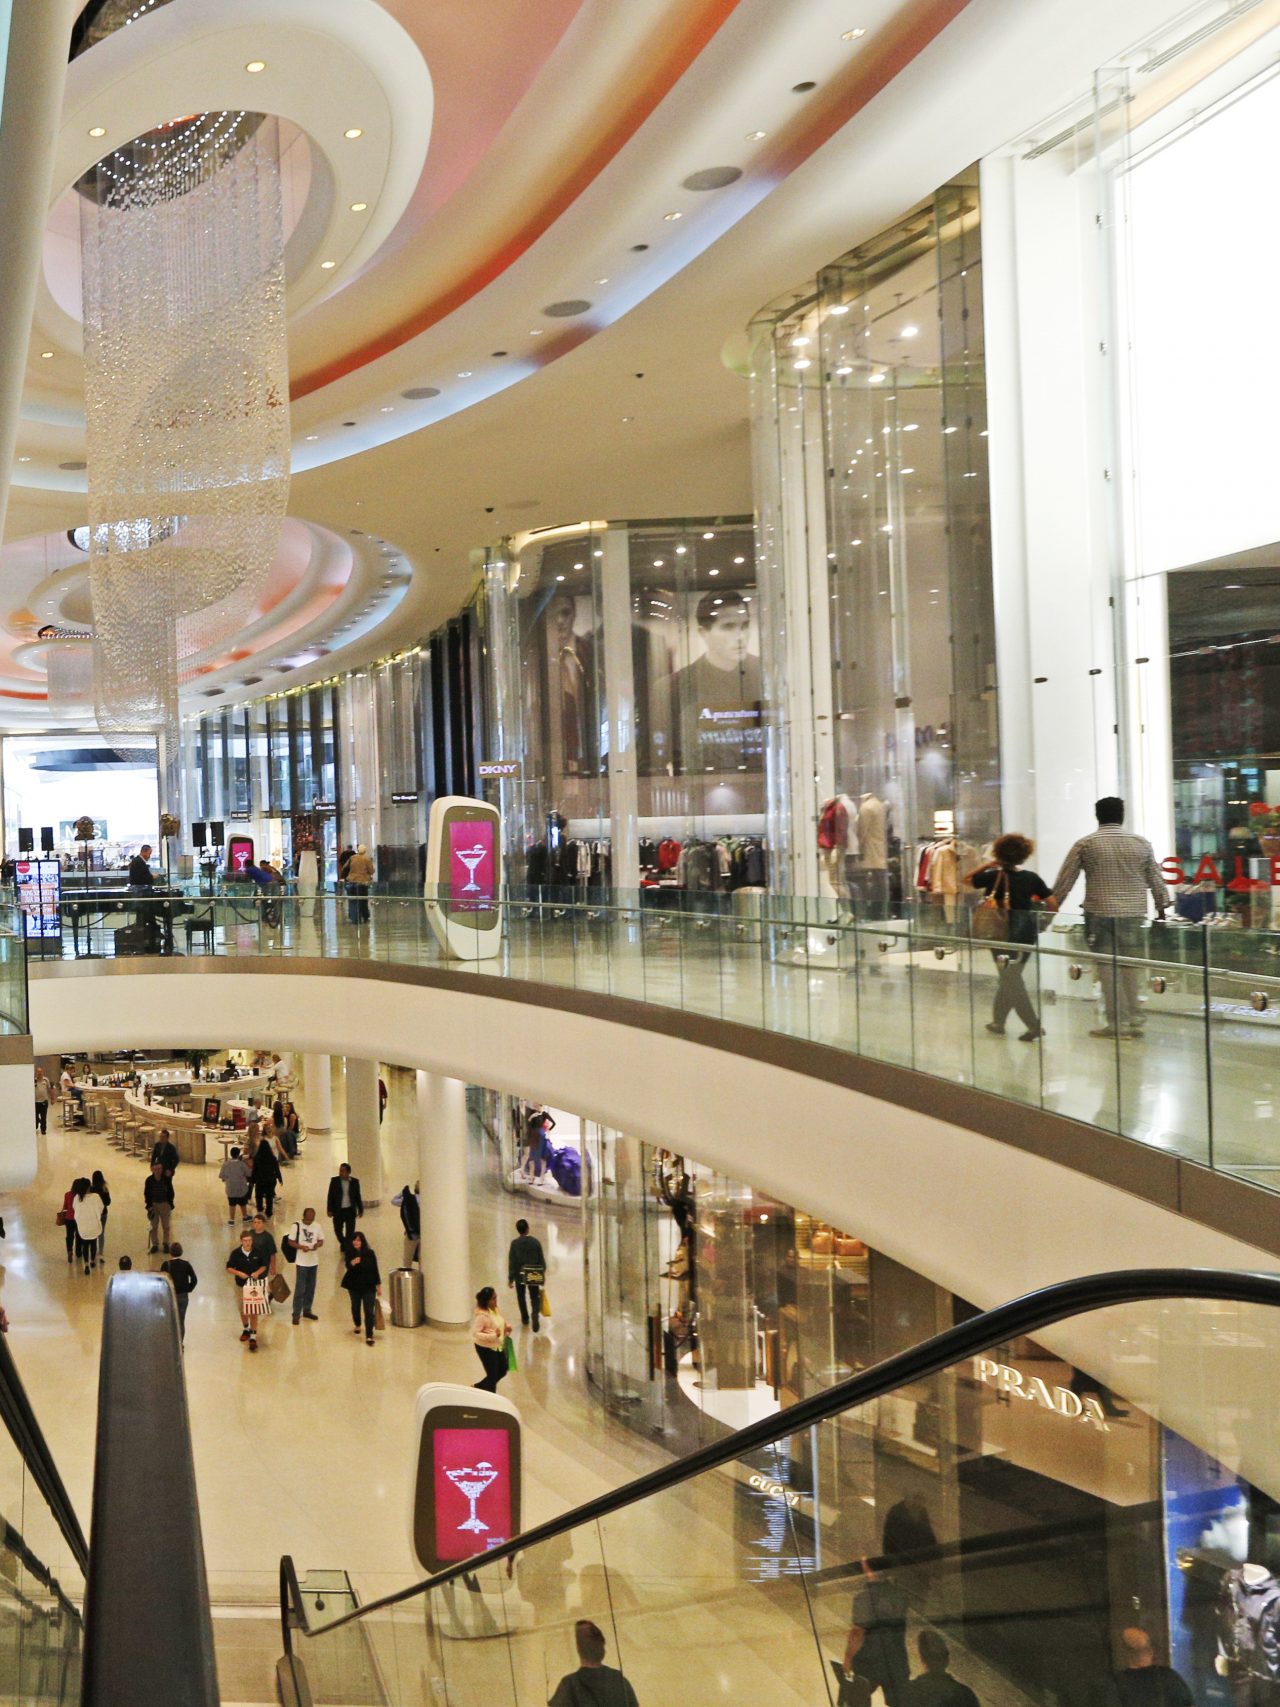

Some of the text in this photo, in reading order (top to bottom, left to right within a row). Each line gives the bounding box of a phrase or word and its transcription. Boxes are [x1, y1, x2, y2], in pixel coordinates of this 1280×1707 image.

[479, 764, 517, 775] DKNY
[65, 824, 102, 840] MS
[1161, 854, 1280, 886] SALE
[973, 1354, 1111, 1432] PRADA
[749, 1475, 799, 1506] GUCCI
